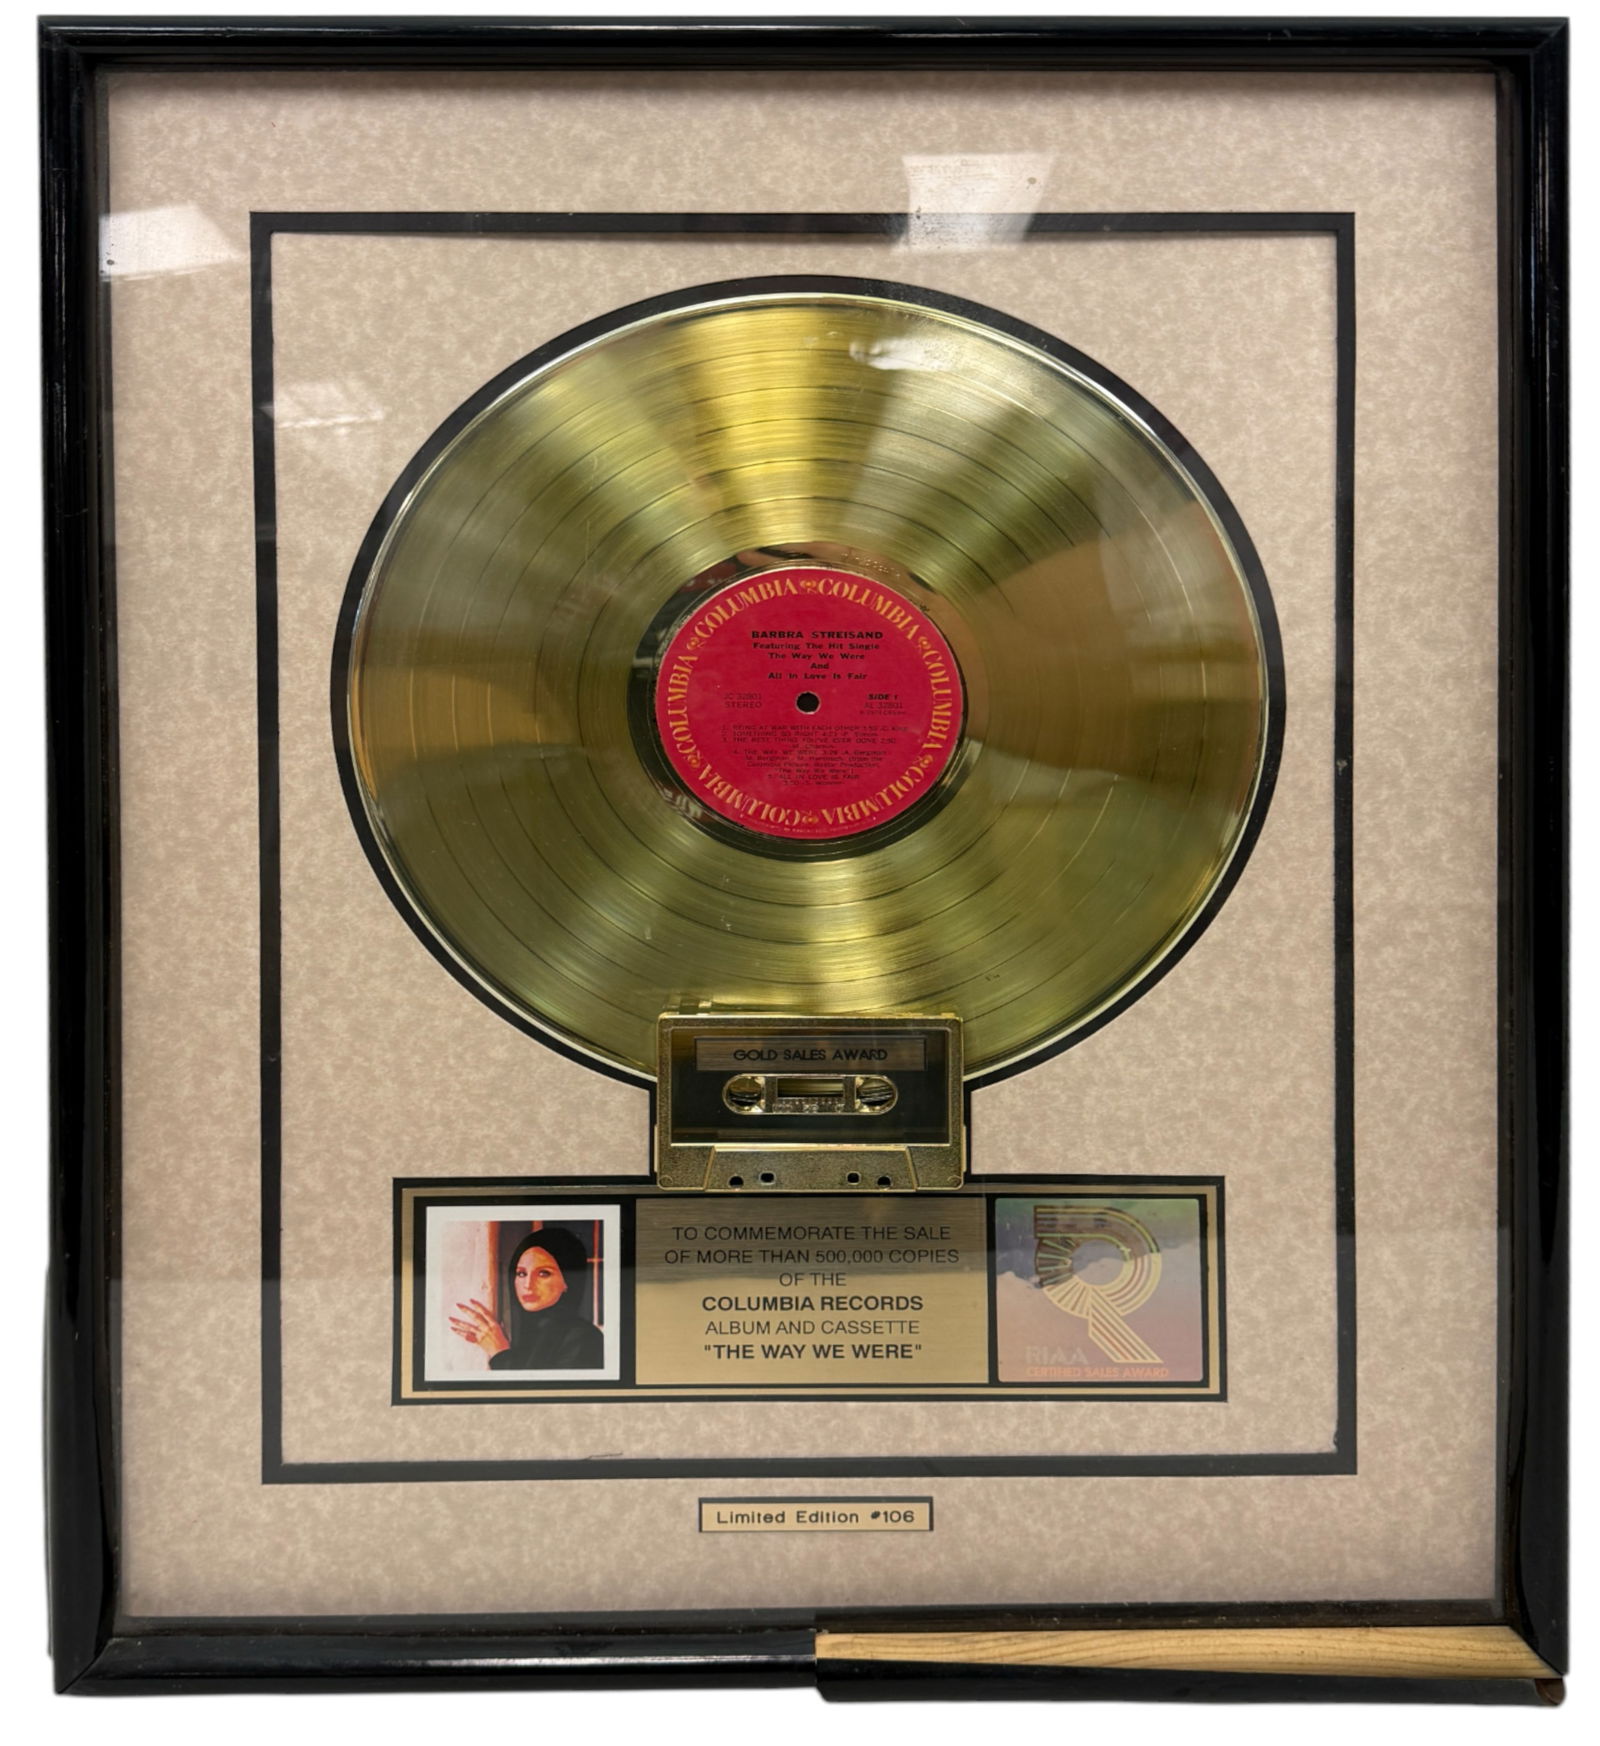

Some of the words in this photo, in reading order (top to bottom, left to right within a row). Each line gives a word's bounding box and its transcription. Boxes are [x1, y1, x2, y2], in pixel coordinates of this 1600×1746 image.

[695, 578, 798, 639] COLUMBIA
[817, 578, 920, 640] COLUMBIA
[752, 631, 804, 639] BARBRA
[811, 631, 884, 639] STREISAND
[752, 643, 801, 651] Featuring
[848, 643, 880, 651] Single
[768, 652, 786, 660] The
[792, 652, 812, 660] Way
[818, 652, 834, 660] We
[840, 652, 865, 660] Were
[810, 662, 830, 670] And
[768, 672, 782, 680] All
[789, 672, 798, 680] In
[804, 672, 827, 680] Love
[833, 672, 841, 680] Is
[847, 672, 868, 680] Fair
[667, 655, 698, 755] COLUMBIA
[725, 701, 763, 709] STEREO
[922, 651, 953, 749] COLUMBIA
[698, 764, 800, 826] COLUMBIA
[820, 765, 925, 825] COLUMBIA
[733, 1049, 778, 1062] GOLD
[784, 1049, 826, 1062] SALES
[832, 1049, 888, 1062] AWARD
[672, 1226, 698, 1241] TO
[704, 1226, 855, 1241] COMMEMORATE
[861, 1226, 897, 1241] THE
[903, 1226, 951, 1241] SALE
[664, 1250, 690, 1264] OF
[696, 1250, 753, 1264] MORE
[758, 1250, 810, 1264] THAN
[815, 1250, 884, 1264] 500,000
[888, 1250, 960, 1264] COPIES
[779, 1272, 805, 1287] OF
[809, 1272, 847, 1287] THE
[702, 1296, 815, 1311] COLUMBIA
[820, 1296, 924, 1311] RECORDS
[705, 1320, 771, 1335] ALBUM
[775, 1320, 816, 1335] AND
[820, 1320, 920, 1335] CASSETTE
[704, 1344, 755, 1359] "THE
[761, 1344, 806, 1359] WAY
[812, 1344, 845, 1359] WE
[851, 1344, 922, 1359] WERE"
[1025, 1346, 1089, 1365] RIAA
[1027, 1366, 1082, 1378] CERTIFIED
[1085, 1366, 1120, 1378] SALES
[1122, 1366, 1171, 1378] AWARD
[716, 1510, 786, 1524] Limited
[796, 1510, 859, 1524] Edition
[870, 1510, 915, 1524] #106
